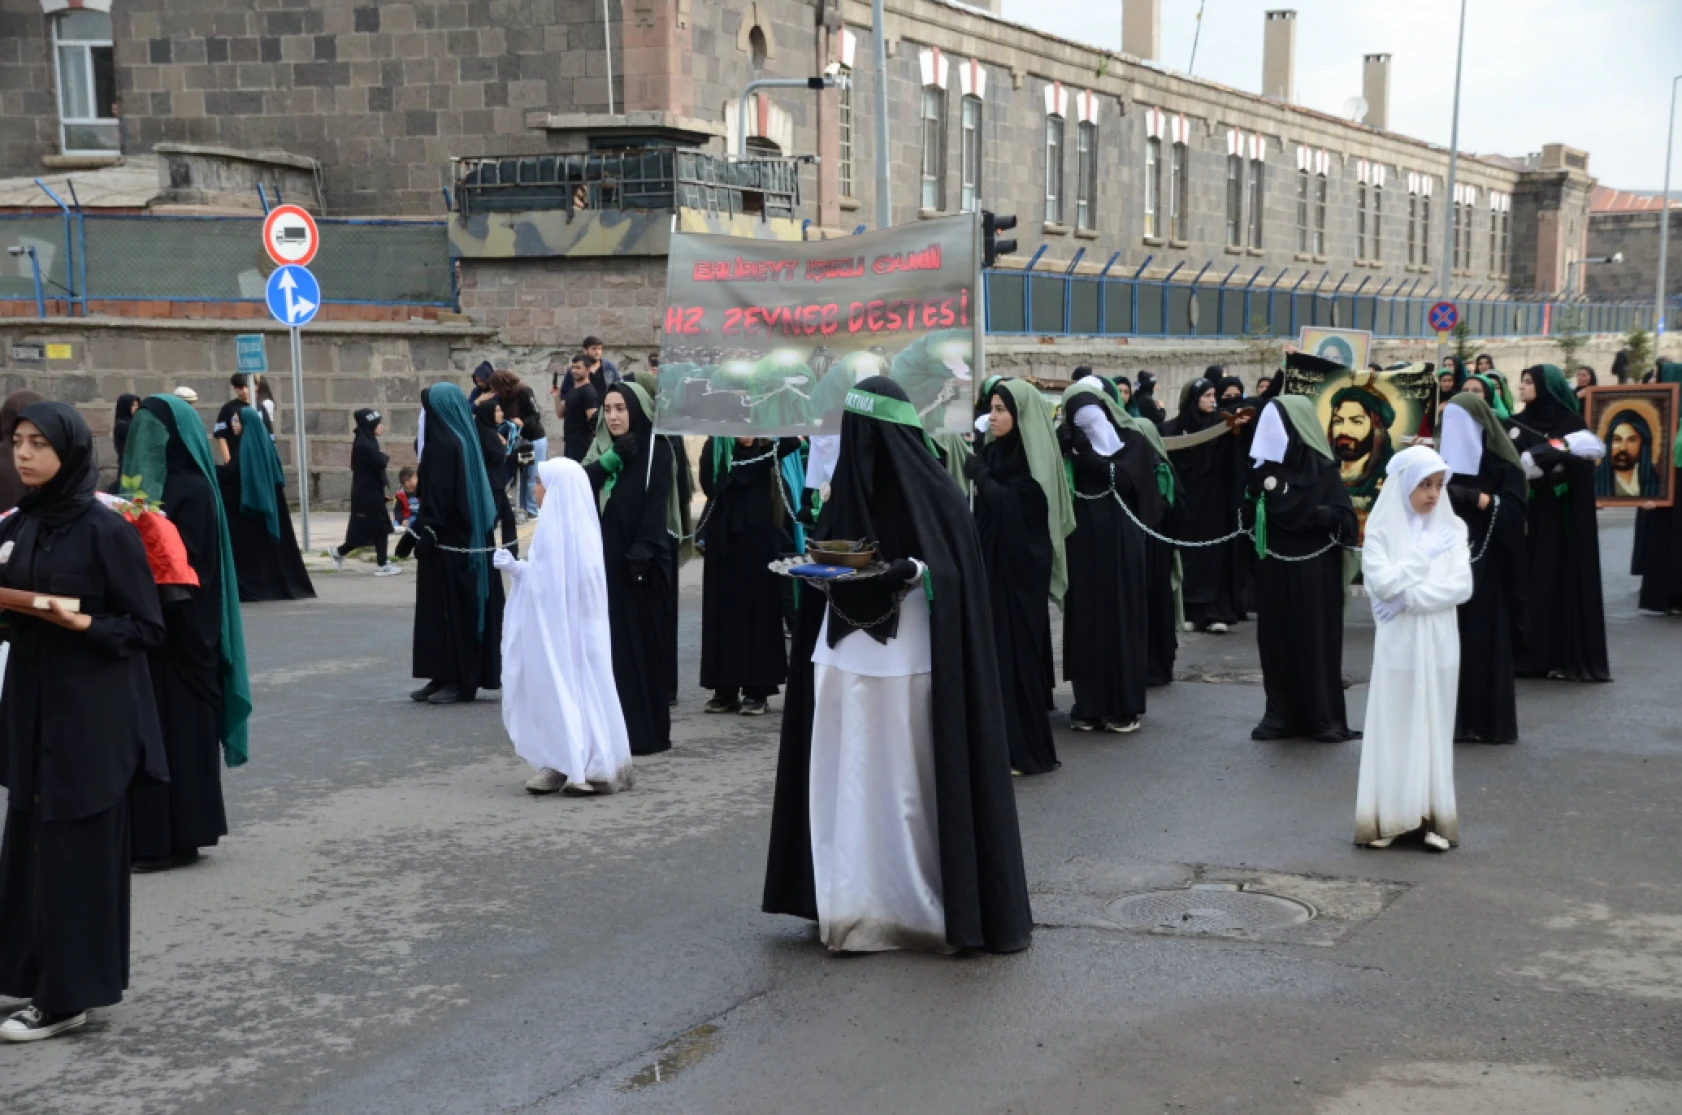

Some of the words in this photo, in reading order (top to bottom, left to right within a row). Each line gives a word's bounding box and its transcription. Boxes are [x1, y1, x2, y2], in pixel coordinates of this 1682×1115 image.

[665, 305, 711, 336] HZ.
[721, 303, 839, 340] ZEYNEB
[847, 288, 968, 336] DESTESİ
